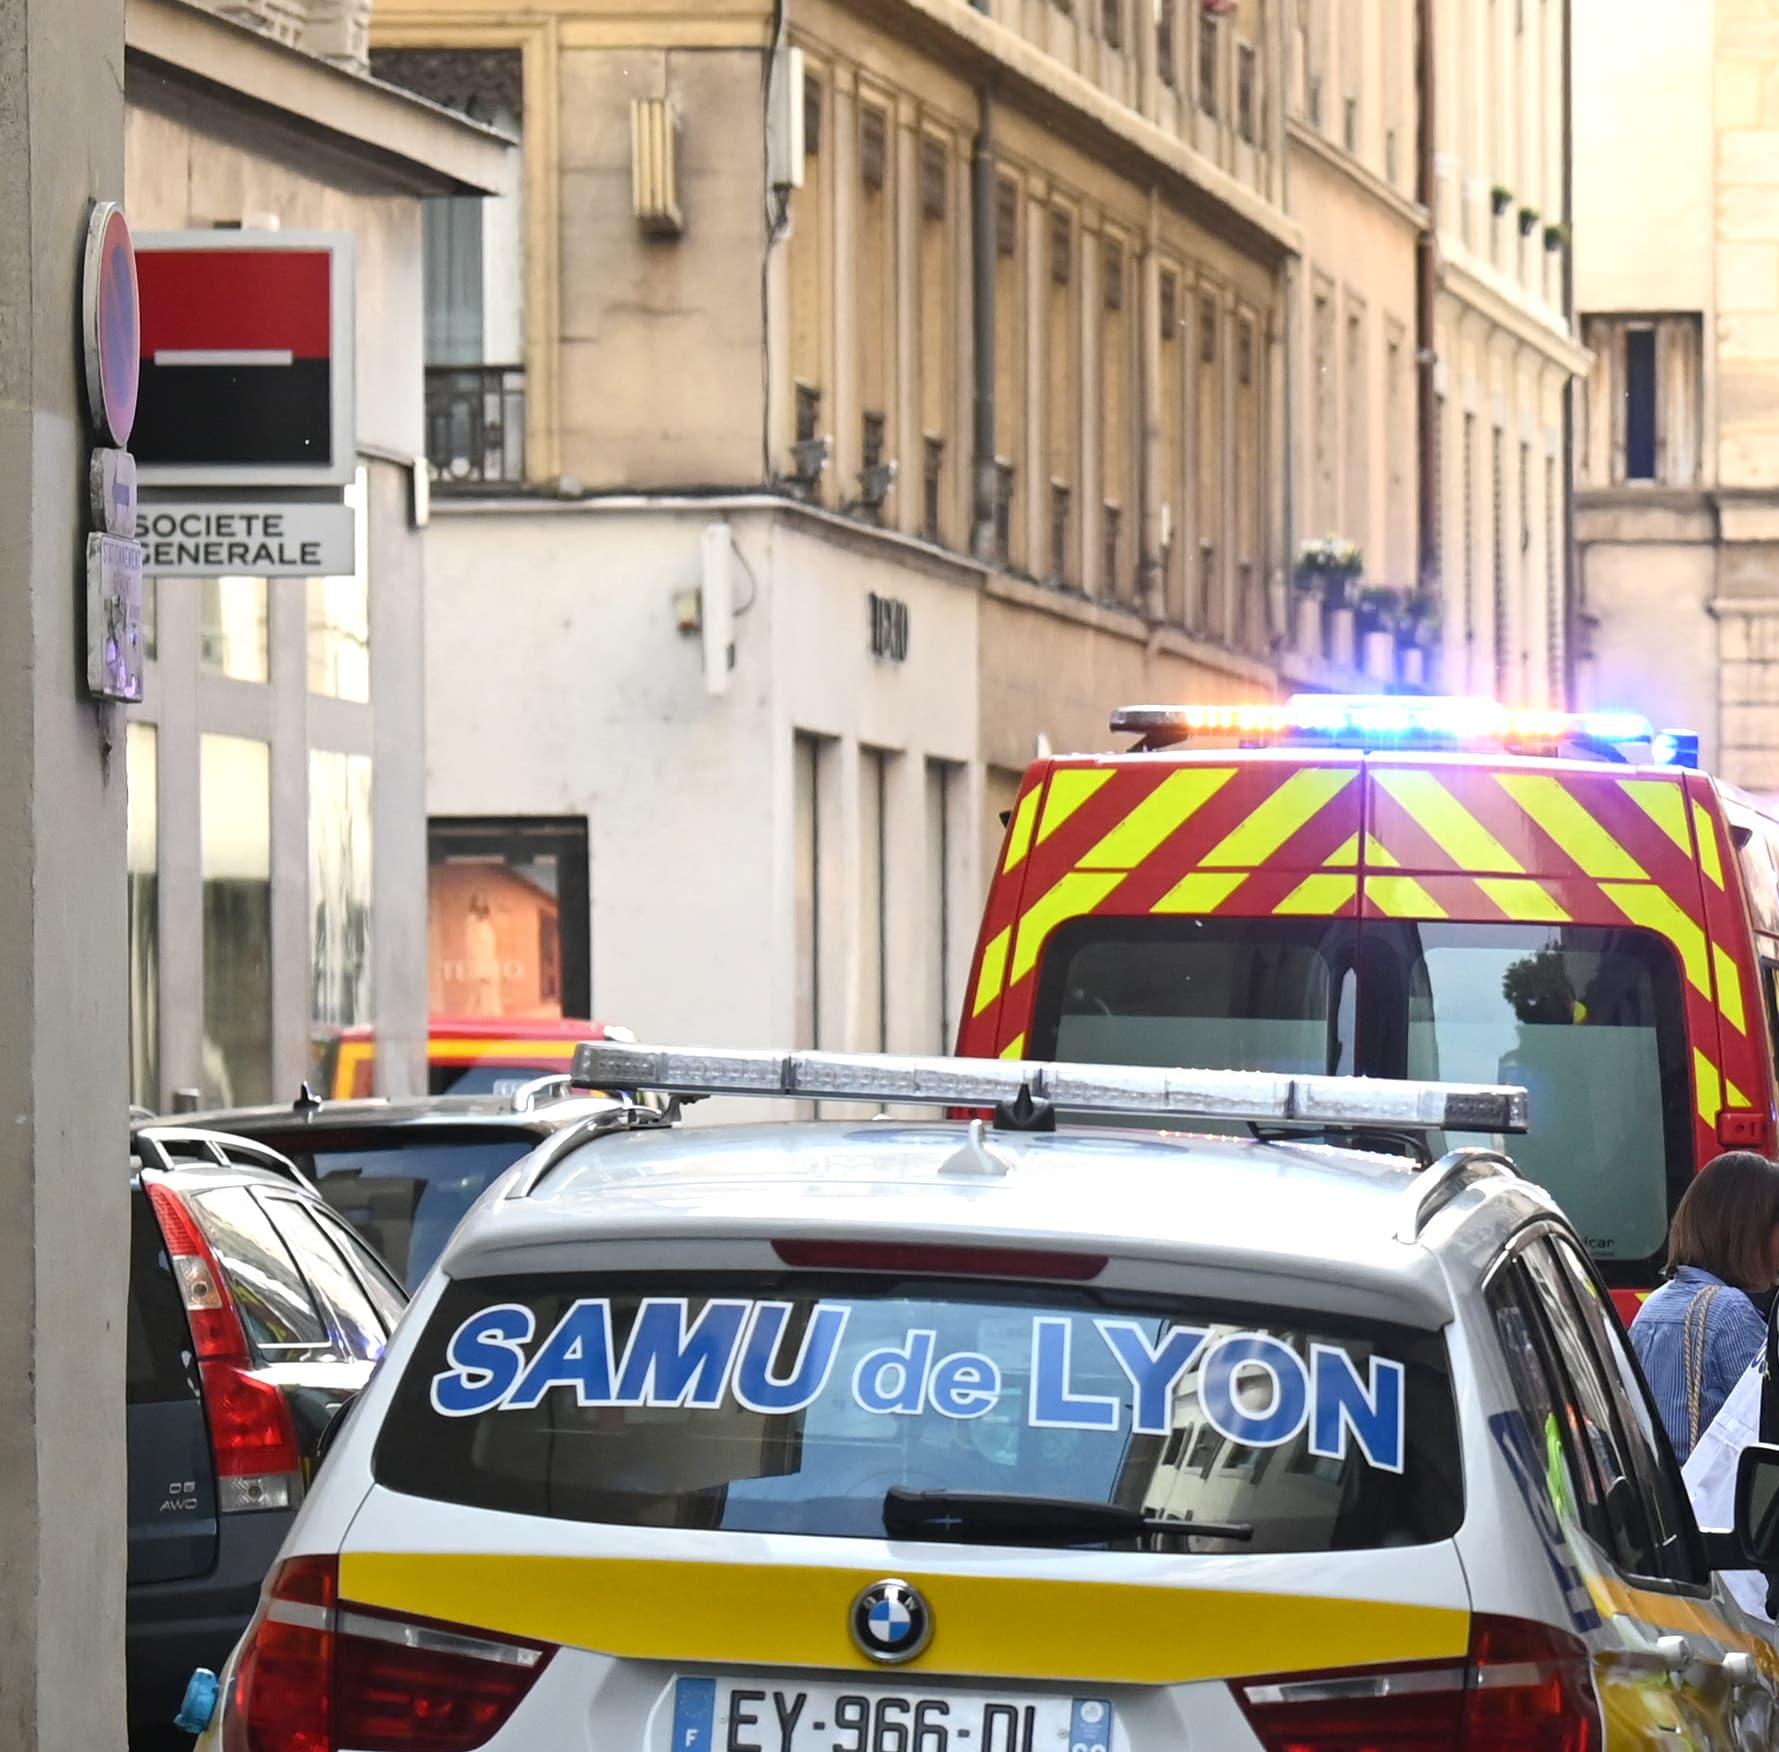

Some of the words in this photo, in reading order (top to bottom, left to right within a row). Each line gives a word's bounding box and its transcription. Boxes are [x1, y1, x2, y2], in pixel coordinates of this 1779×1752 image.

[136, 514, 284, 538] SOCIETE
[430, 1298, 850, 1416] SAMU
[851, 1329, 1001, 1419] de
[1029, 1316, 1406, 1474] LYON
[685, 1728, 699, 1748] F
